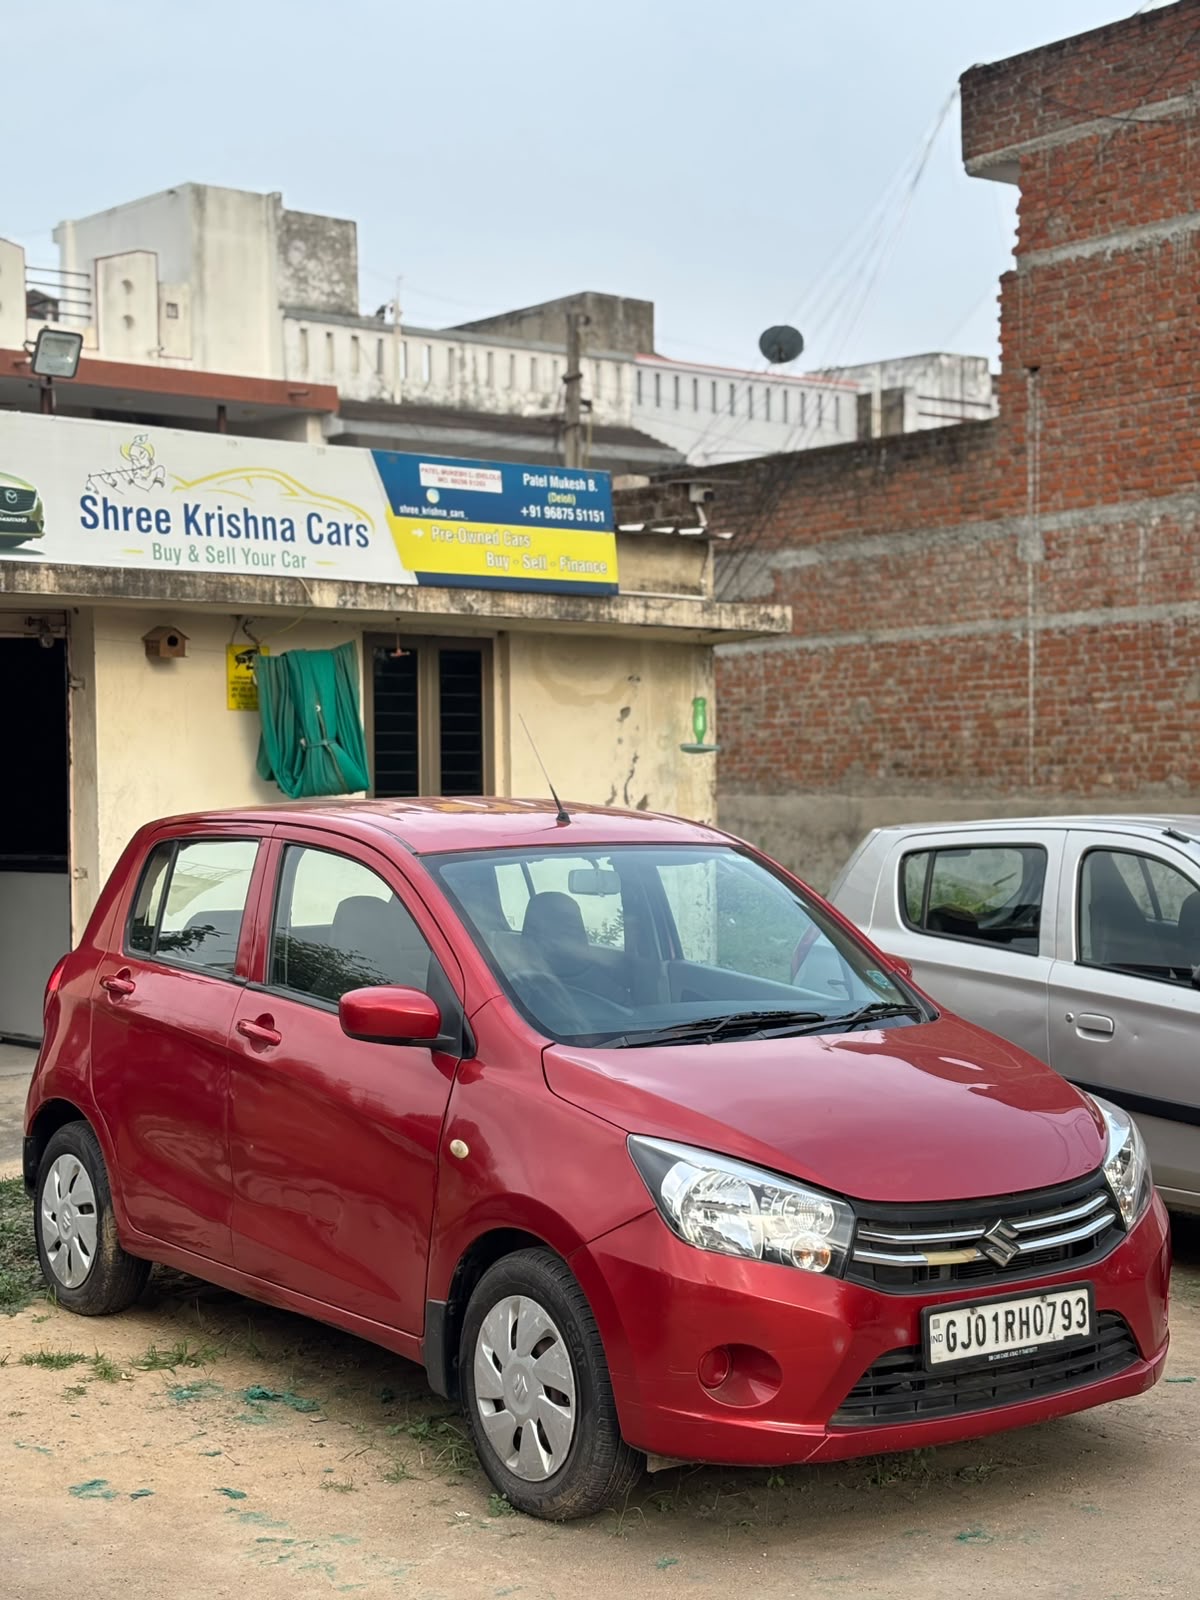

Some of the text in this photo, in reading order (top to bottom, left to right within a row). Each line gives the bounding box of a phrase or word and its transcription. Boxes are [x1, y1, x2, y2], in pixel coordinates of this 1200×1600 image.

[523, 473, 598, 492] Patel Mukesh B.
[80, 495, 370, 548] Shree Krishna Cars
[520, 504, 605, 523] +91 96875 51151
[431, 526, 531, 547] Pre-Owned Cars
[152, 543, 307, 569] Buy & Sell Your Car
[486, 551, 510, 572] Buy
[523, 556, 547, 570] Sell
[560, 557, 607, 575] Finance
[945, 1297, 1087, 1353] GJ01RH0793
[930, 1333, 943, 1344] IND
